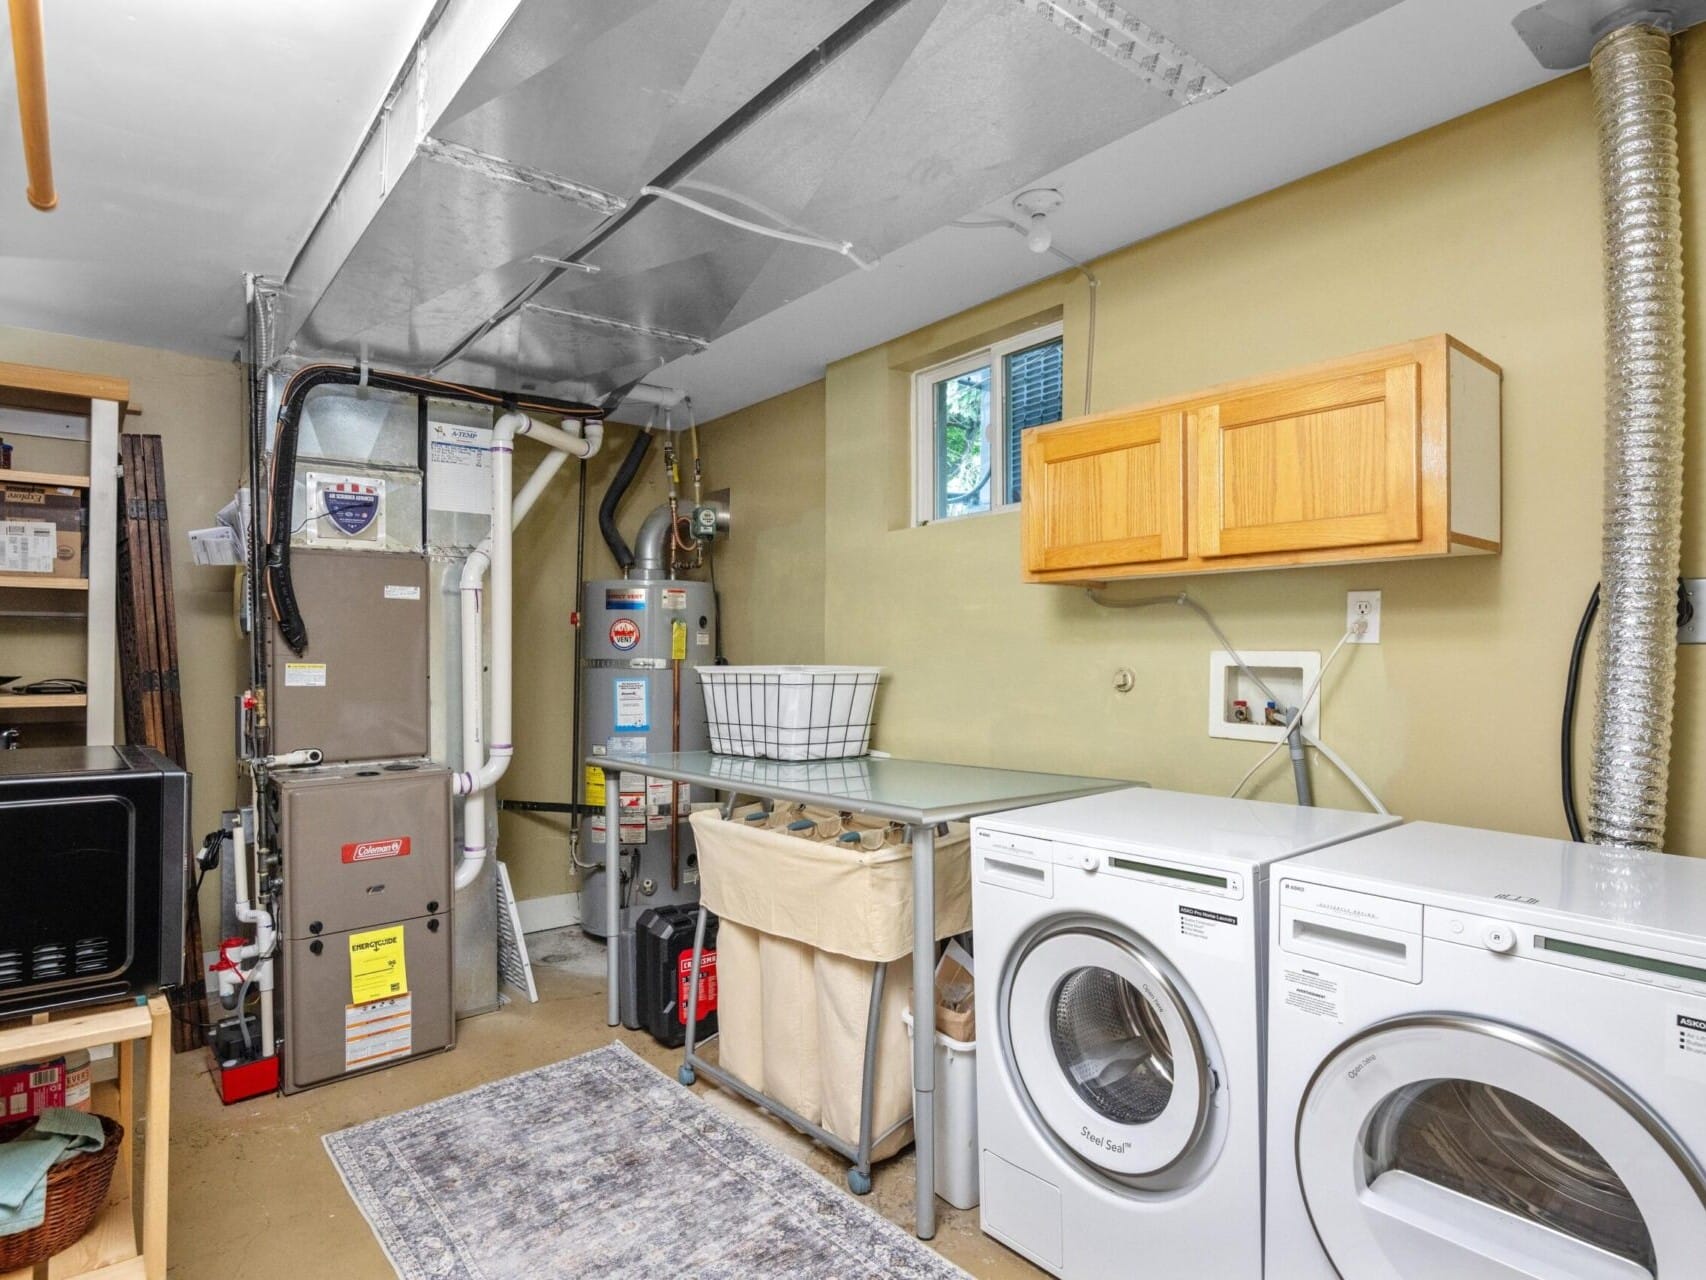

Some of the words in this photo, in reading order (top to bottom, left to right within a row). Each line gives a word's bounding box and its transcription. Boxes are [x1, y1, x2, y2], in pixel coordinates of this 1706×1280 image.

[7, 492, 42, 503] Explore
[358, 845, 391, 856] Coleman
[1680, 1017, 1706, 1030] ASKO
[1080, 1126, 1104, 1148] Steel
